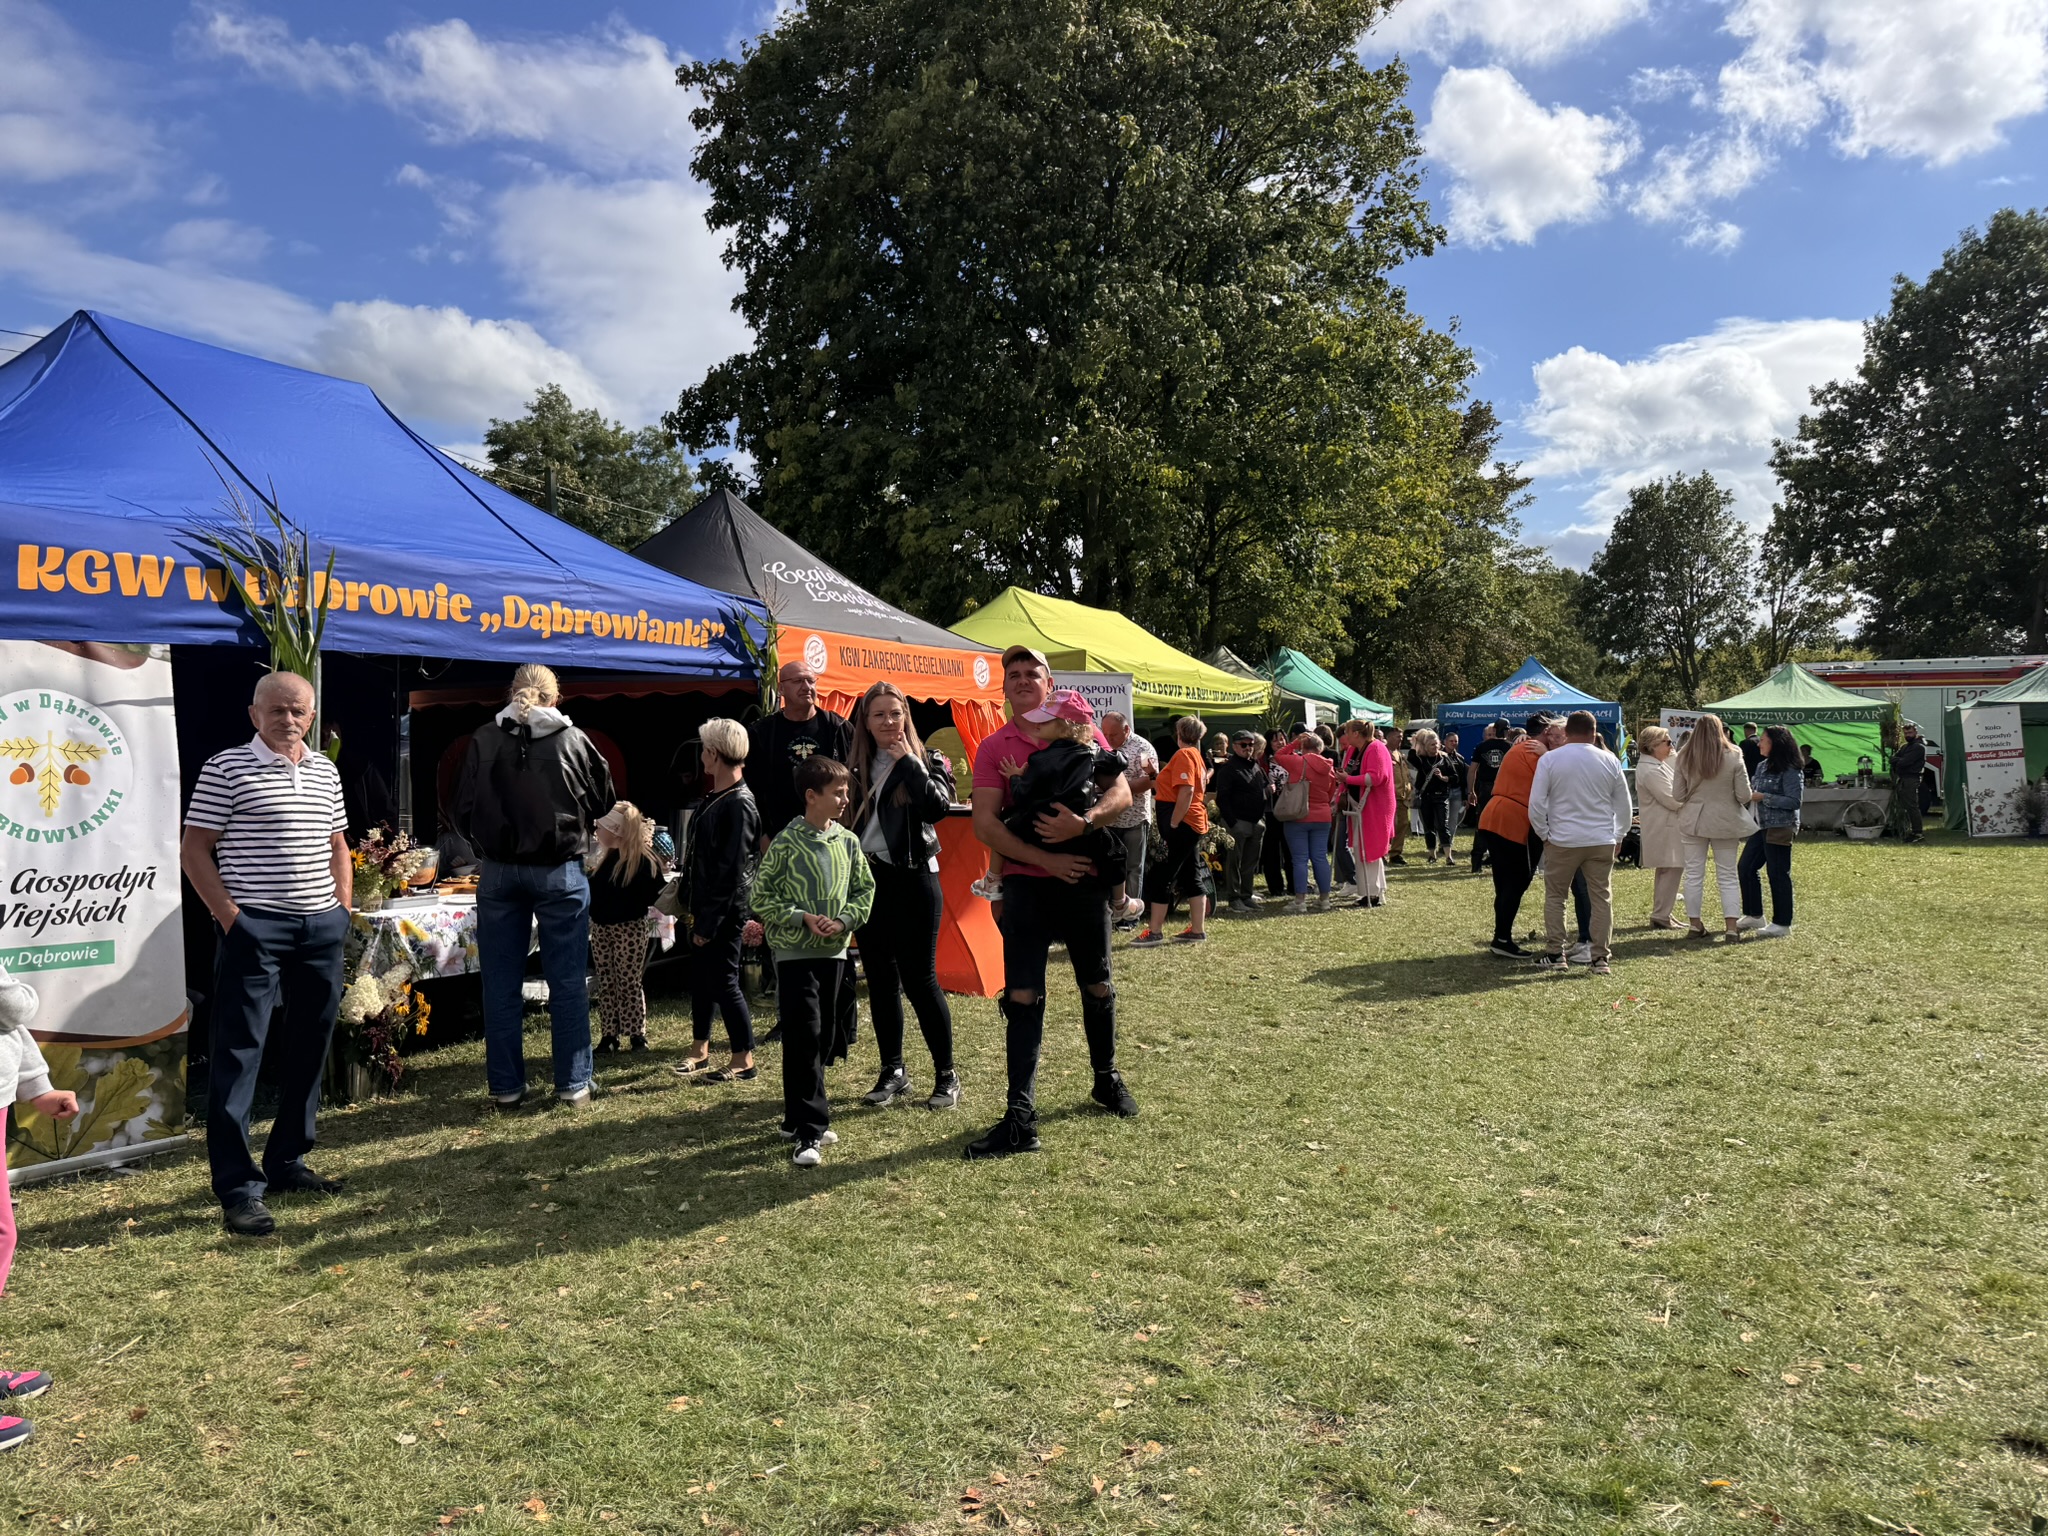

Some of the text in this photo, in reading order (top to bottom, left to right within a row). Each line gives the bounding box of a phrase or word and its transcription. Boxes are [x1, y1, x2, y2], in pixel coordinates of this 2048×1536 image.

[18, 545, 176, 597] KGW
[184, 567, 232, 602] w
[244, 566, 472, 622] Dąbrowie
[839, 646, 860, 667] KGW
[862, 648, 912, 675] ZAKRĘCONE
[913, 655, 965, 678] CEGIELNIANKI
[1070, 684, 1127, 696] GOSPODYŃ
[14, 693, 123, 755] w Dąbrowie
[1445, 710, 1465, 719] KGW
[1737, 711, 1805, 721] MDZEWKO
[0, 788, 124, 844] BROWIANKI
[18, 945, 99, 968] Dąbrowie
